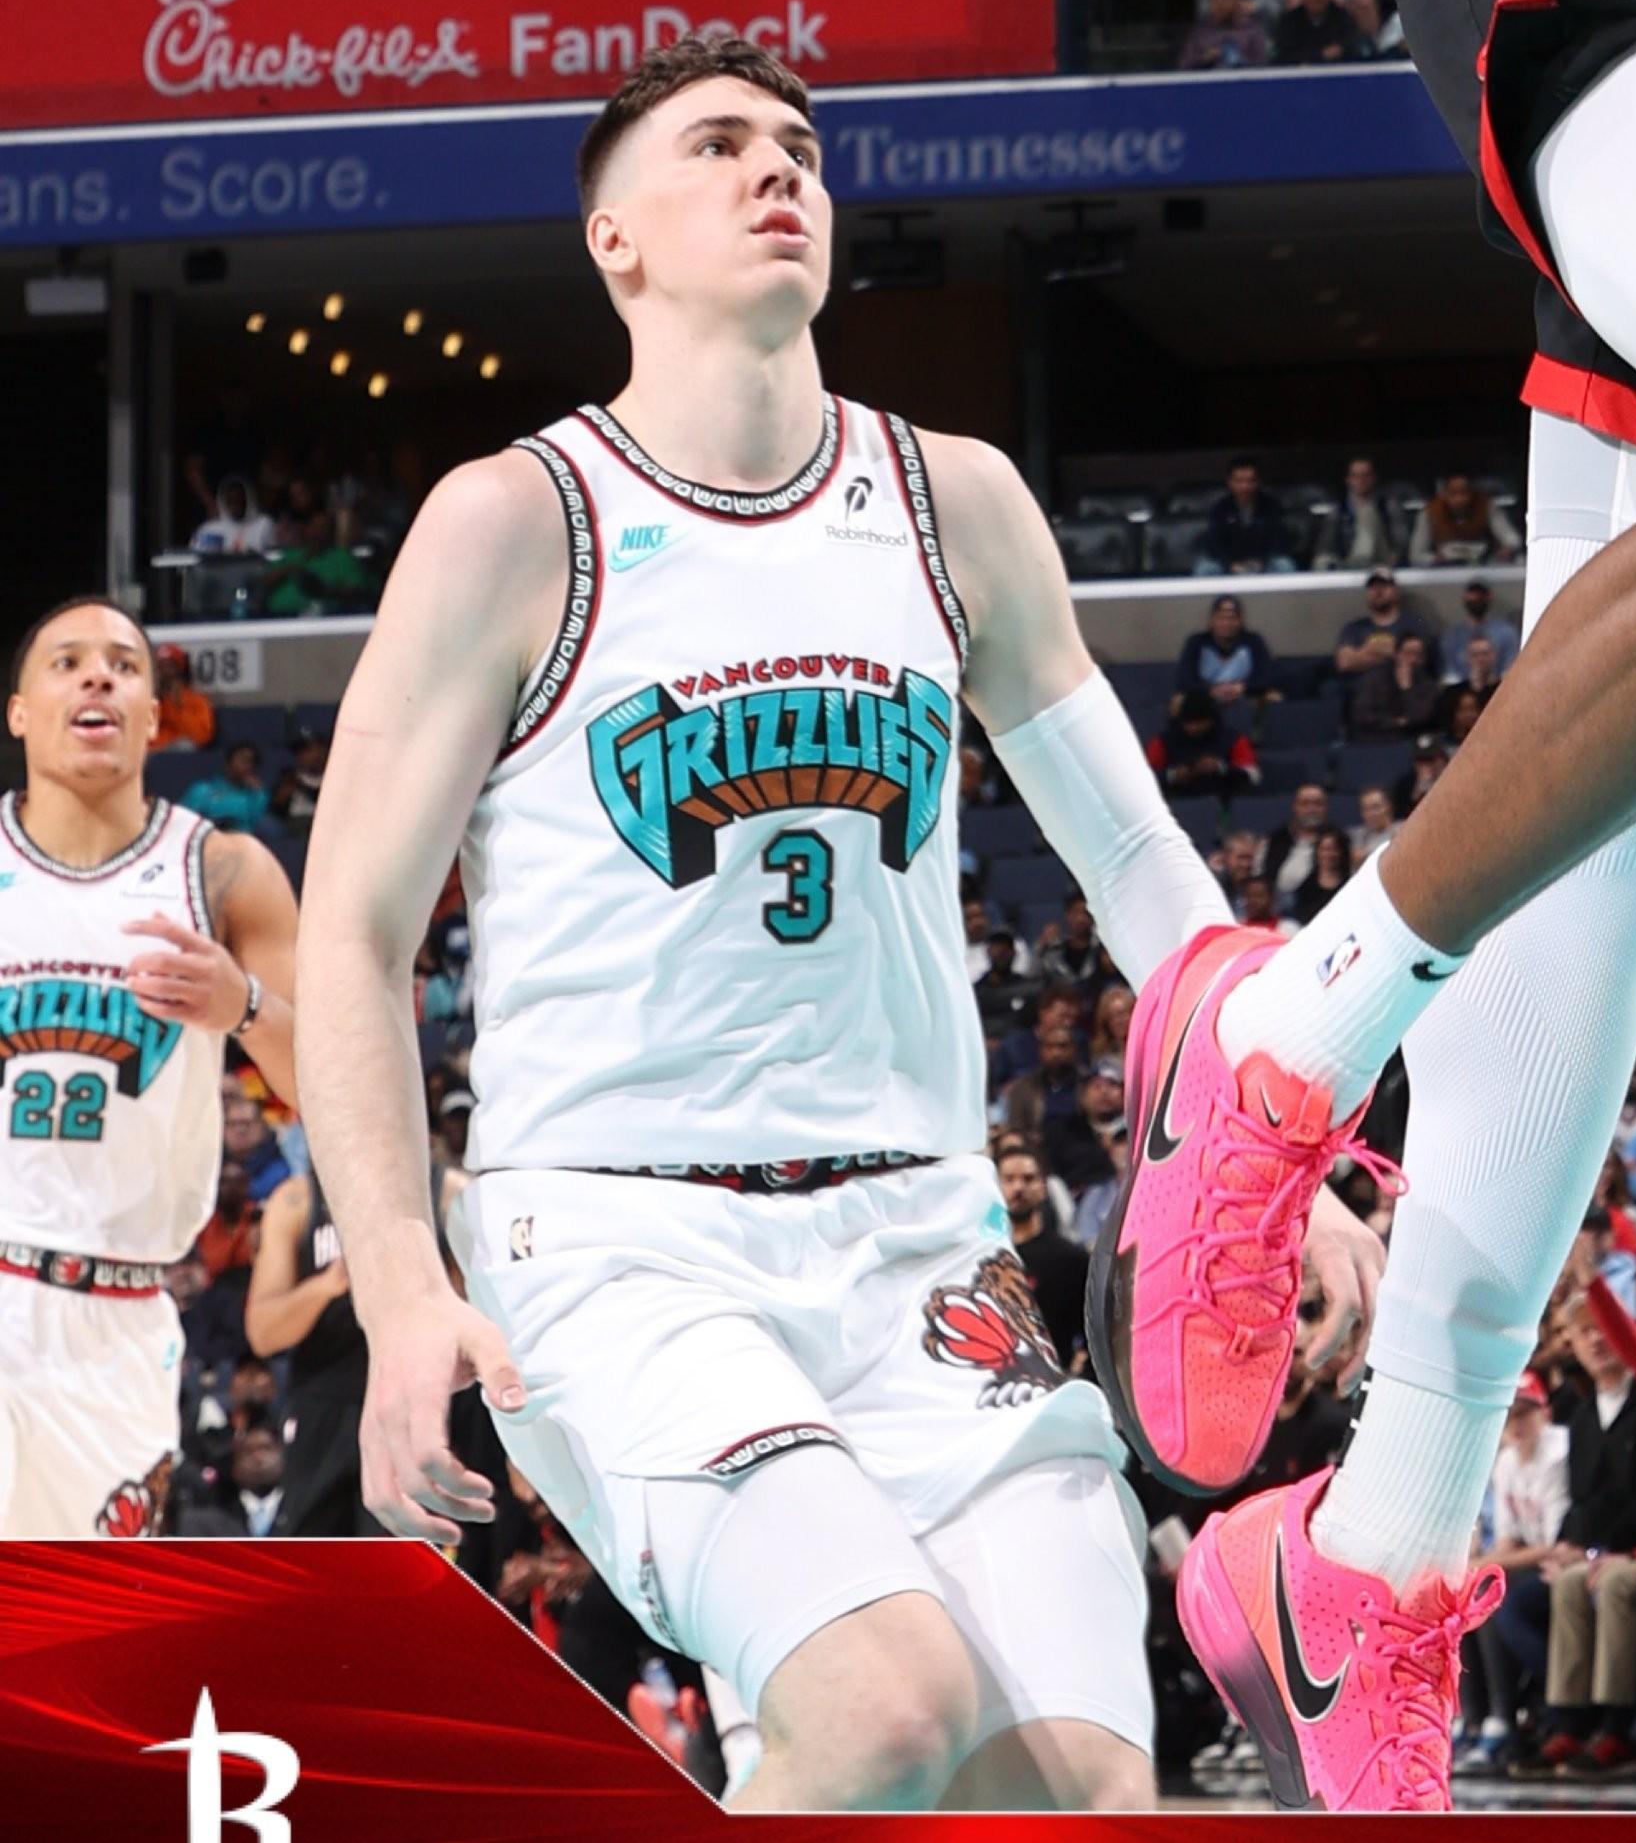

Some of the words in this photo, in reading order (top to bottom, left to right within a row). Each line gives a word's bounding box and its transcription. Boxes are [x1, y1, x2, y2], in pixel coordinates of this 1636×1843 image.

[160, 145, 391, 220] Score.
[836, 122, 1186, 188] Tennessee
[619, 524, 668, 552] NIKE
[824, 524, 909, 548] Robinhood
[672, 652, 894, 699] VANCOUVER
[585, 666, 952, 891] GRIZZLIES
[762, 828, 834, 945] 3
[9, 1069, 108, 1142] 22
